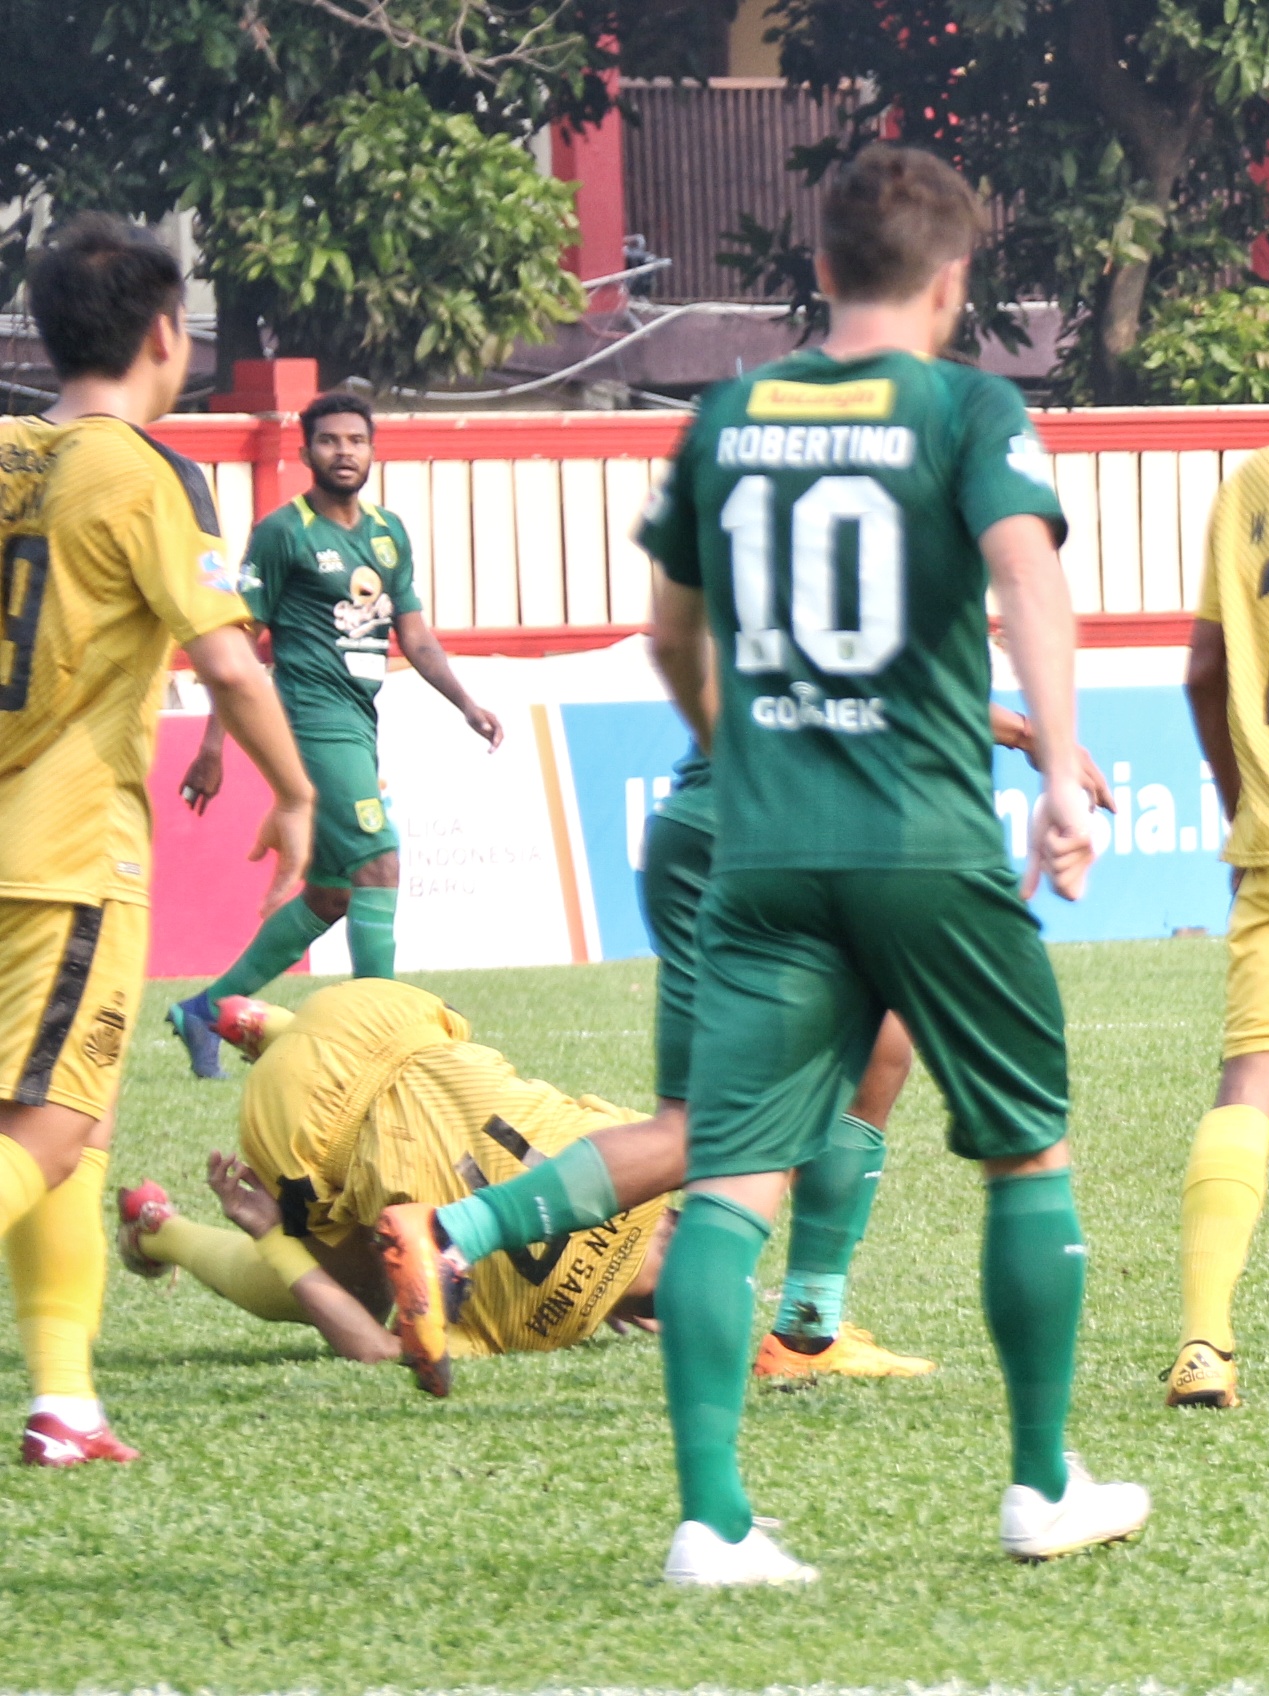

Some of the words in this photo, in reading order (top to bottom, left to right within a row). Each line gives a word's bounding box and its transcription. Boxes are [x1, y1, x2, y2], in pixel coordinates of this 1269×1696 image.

[716, 425, 916, 470] ROBERTINO
[719, 474, 908, 675] 10
[406, 817, 465, 839] LIGA
[407, 845, 543, 867] INDONESIA
[408, 875, 478, 898] BARU
[1175, 1367, 1222, 1388] adidas
